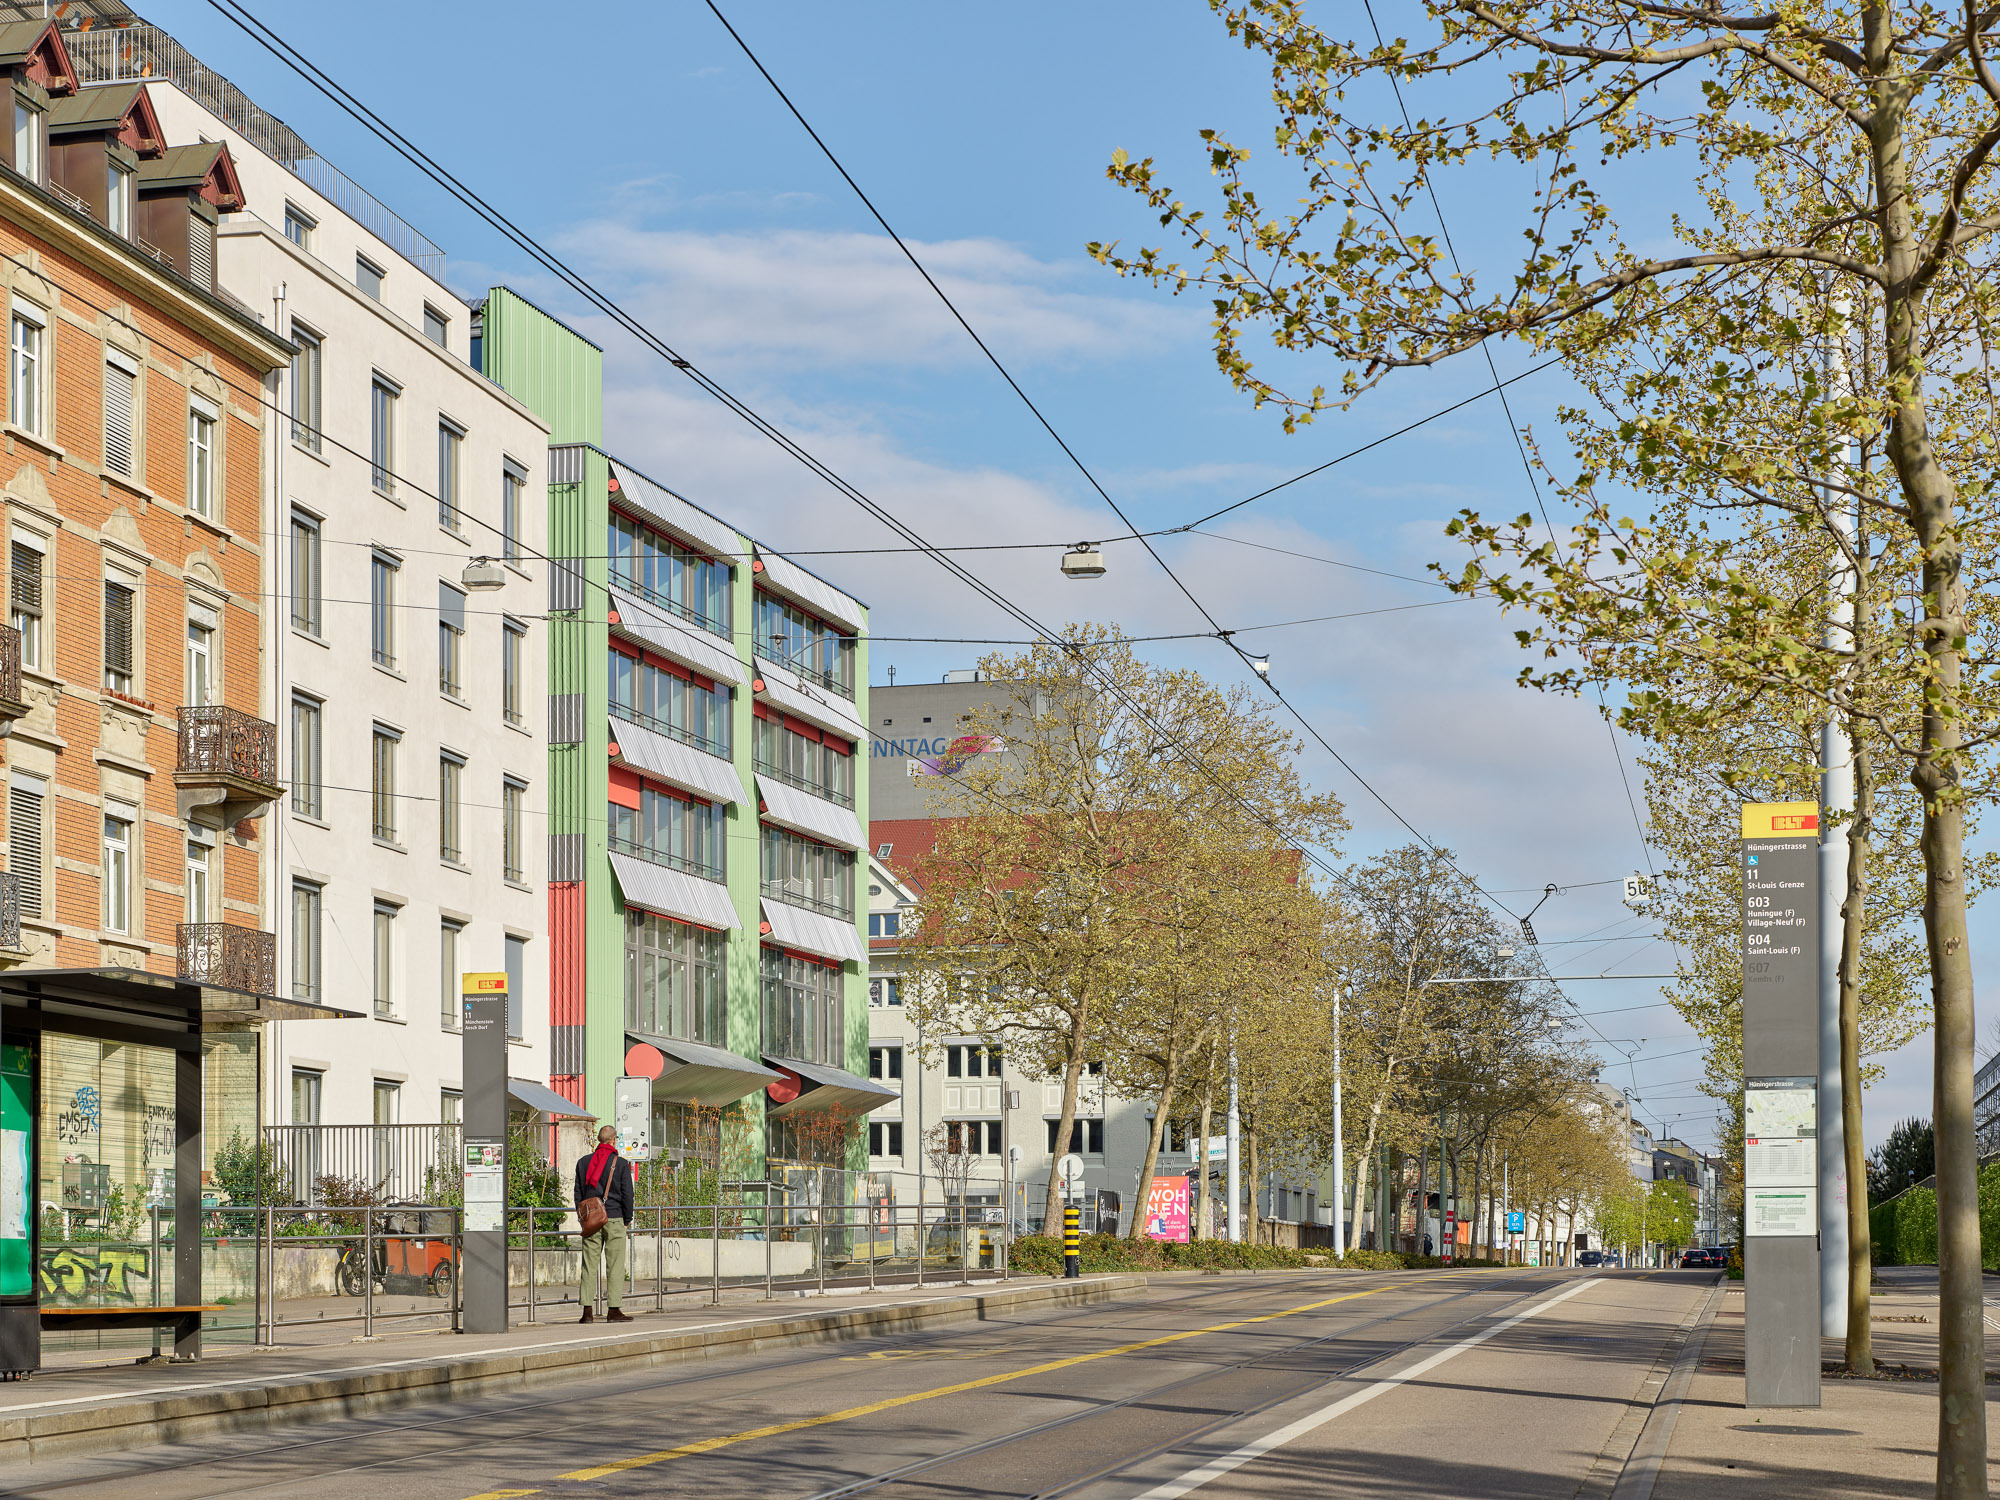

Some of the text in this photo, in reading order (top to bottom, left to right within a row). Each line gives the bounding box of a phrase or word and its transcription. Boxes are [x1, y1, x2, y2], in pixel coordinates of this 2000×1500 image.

[1747, 842, 1807, 851] Hüningerstrasse
[1746, 869, 1758, 880] 11
[1627, 881, 1648, 897] 50
[1747, 881, 1805, 889] St-Louis Grenze
[1747, 896, 1770, 908] 603
[1747, 909, 1795, 918] Huningue (F)
[1747, 918, 1806, 927] Village-Neuf (F)
[1747, 934, 1771, 945] 604
[1747, 946, 1801, 955] Saint-Louis (F)
[1748, 963, 1770, 973] 607
[1748, 1080, 1794, 1088] Hüningerstrasse
[1149, 1189, 1186, 1202] WOH
[1146, 1202, 1186, 1216] NEN
